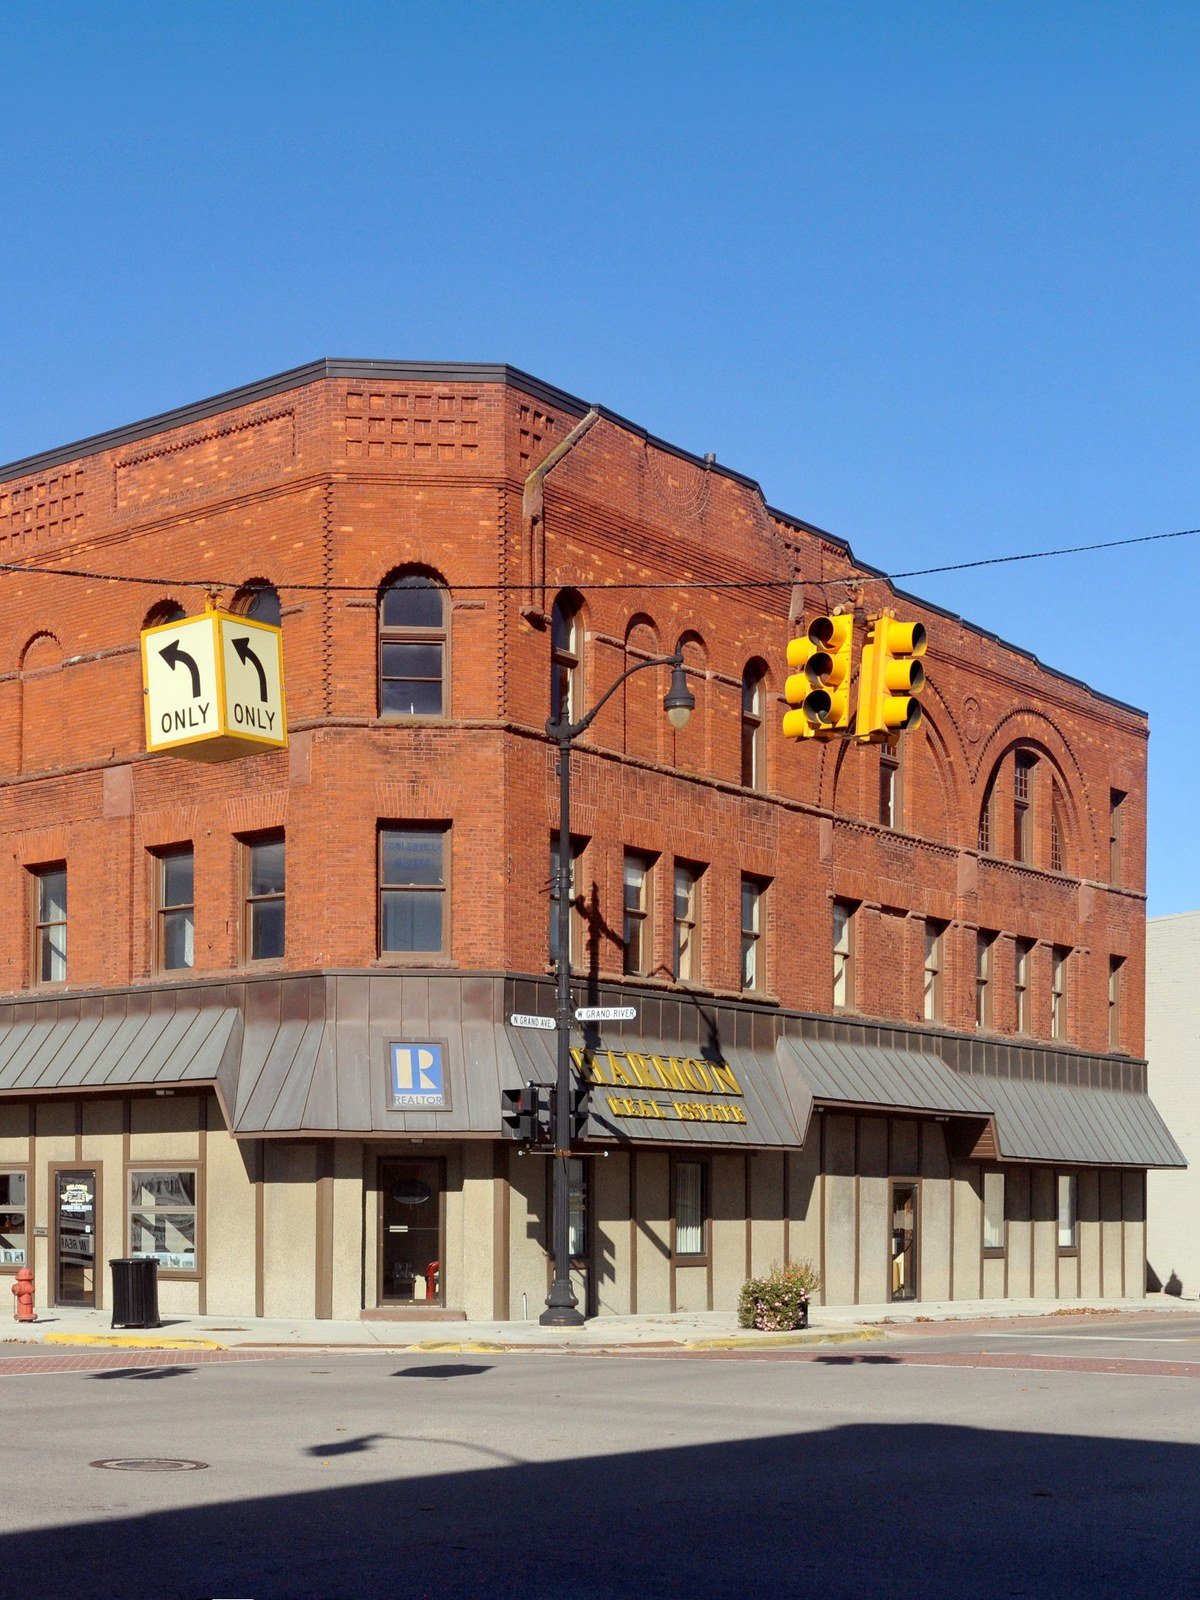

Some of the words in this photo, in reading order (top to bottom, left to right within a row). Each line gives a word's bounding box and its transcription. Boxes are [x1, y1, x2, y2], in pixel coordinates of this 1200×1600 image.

[161, 702, 210, 733] ONLY
[233, 703, 275, 731] ONLY
[520, 1016, 539, 1027] GRAND
[577, 1010, 583, 1018] W
[586, 1009, 610, 1019] GRAND
[613, 1008, 635, 1018] RIVER
[394, 1095, 443, 1105] REALTOR
[606, 1096, 667, 1118] REAL
[671, 1101, 747, 1124] ESTATE
